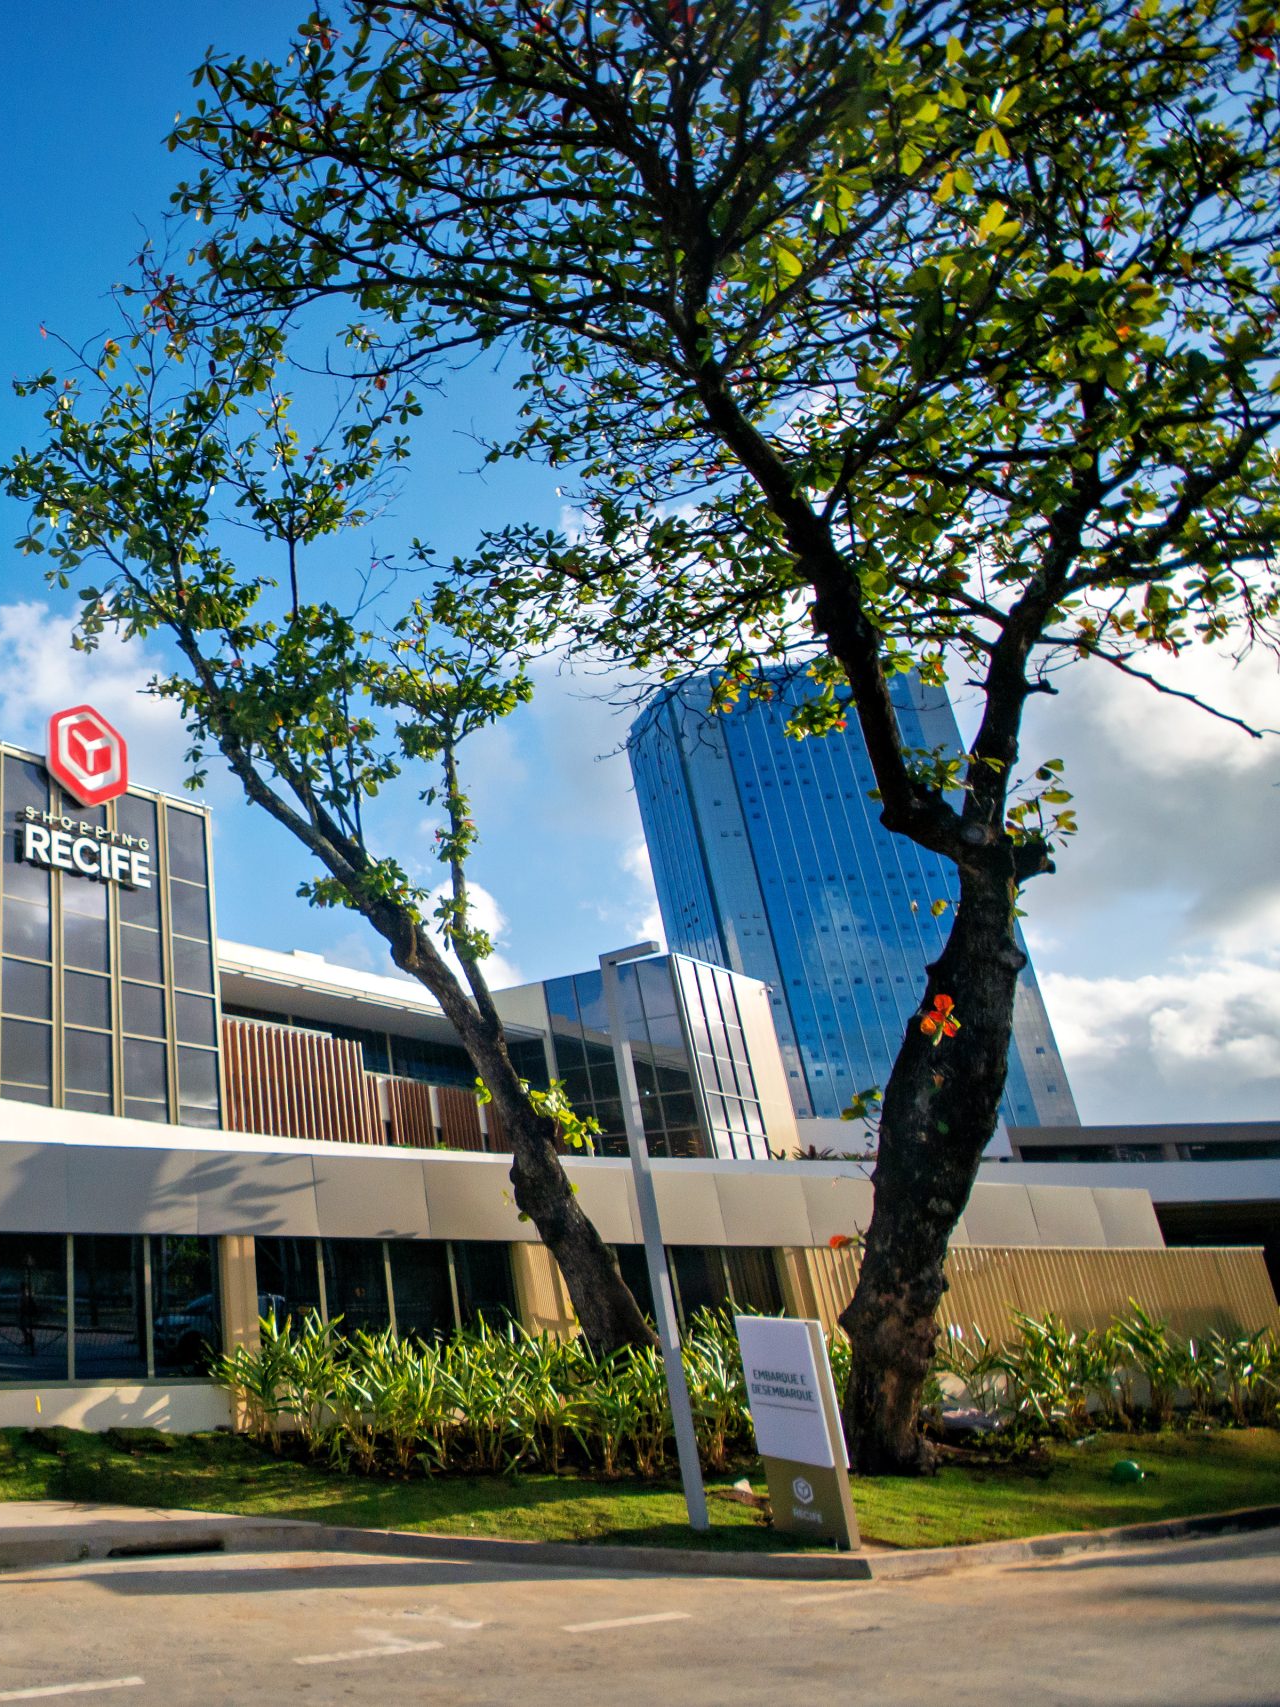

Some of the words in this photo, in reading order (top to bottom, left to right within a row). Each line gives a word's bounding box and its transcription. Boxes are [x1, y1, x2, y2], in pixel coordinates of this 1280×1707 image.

[25, 805, 150, 851] SHOPPING
[25, 822, 151, 888] RECIFE
[751, 1383, 815, 1401] DESEMBARQUE
[753, 1369, 799, 1385] EMBARQUE
[800, 1375, 807, 1386] E
